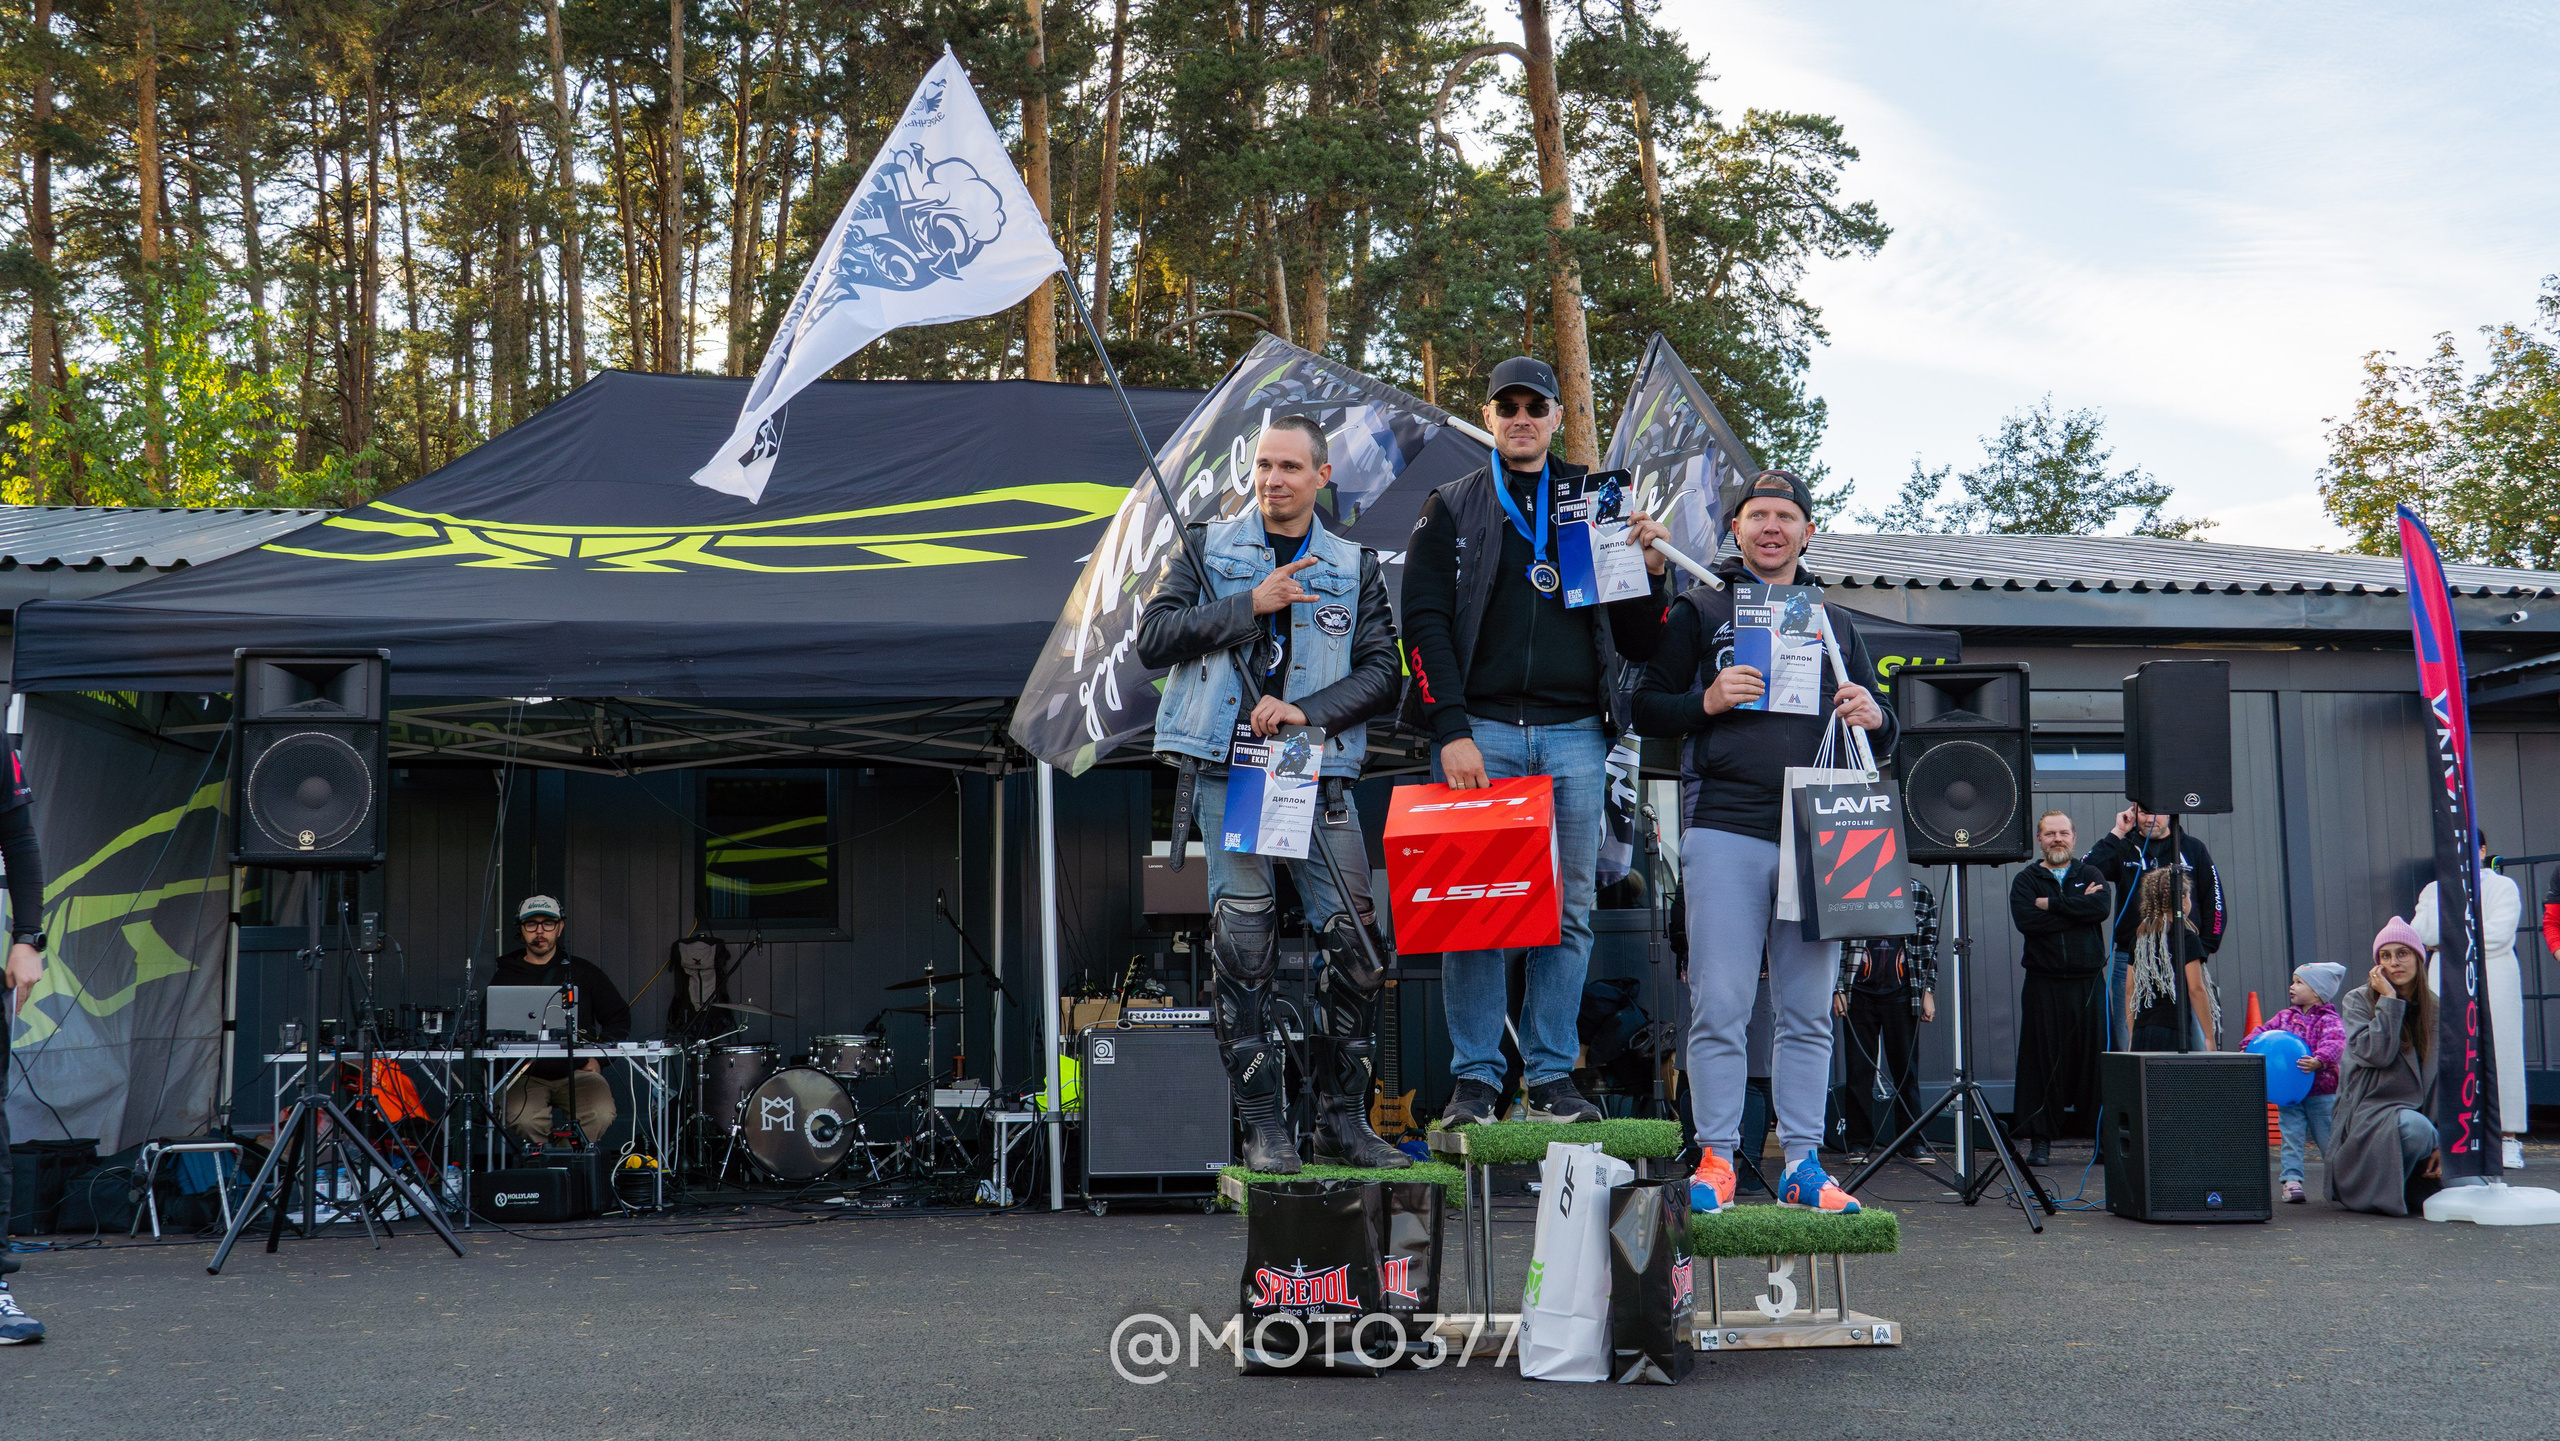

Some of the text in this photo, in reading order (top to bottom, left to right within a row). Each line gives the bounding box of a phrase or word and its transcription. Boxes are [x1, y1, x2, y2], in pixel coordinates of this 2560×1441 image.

[1559, 502, 1587, 513] GYMKHANA
[1573, 510, 1587, 518] EKAT
[1780, 654, 1813, 662] ДИПЛОМ
[1237, 723, 1251, 731] 2025
[1236, 746, 1269, 757] GYMKHANA
[1251, 755, 1268, 765] EKAT
[1272, 796, 1306, 805] ДИПЛОМ
[1814, 795, 1892, 815] LAVR
[1411, 881, 1531, 903] LS2
[1242, 1052, 1265, 1084] MOTEQ
[1252, 1263, 1363, 1309] SPEEDOL
[1754, 1254, 1798, 1319] 3
[1279, 1305, 1326, 1316] Since 1921
